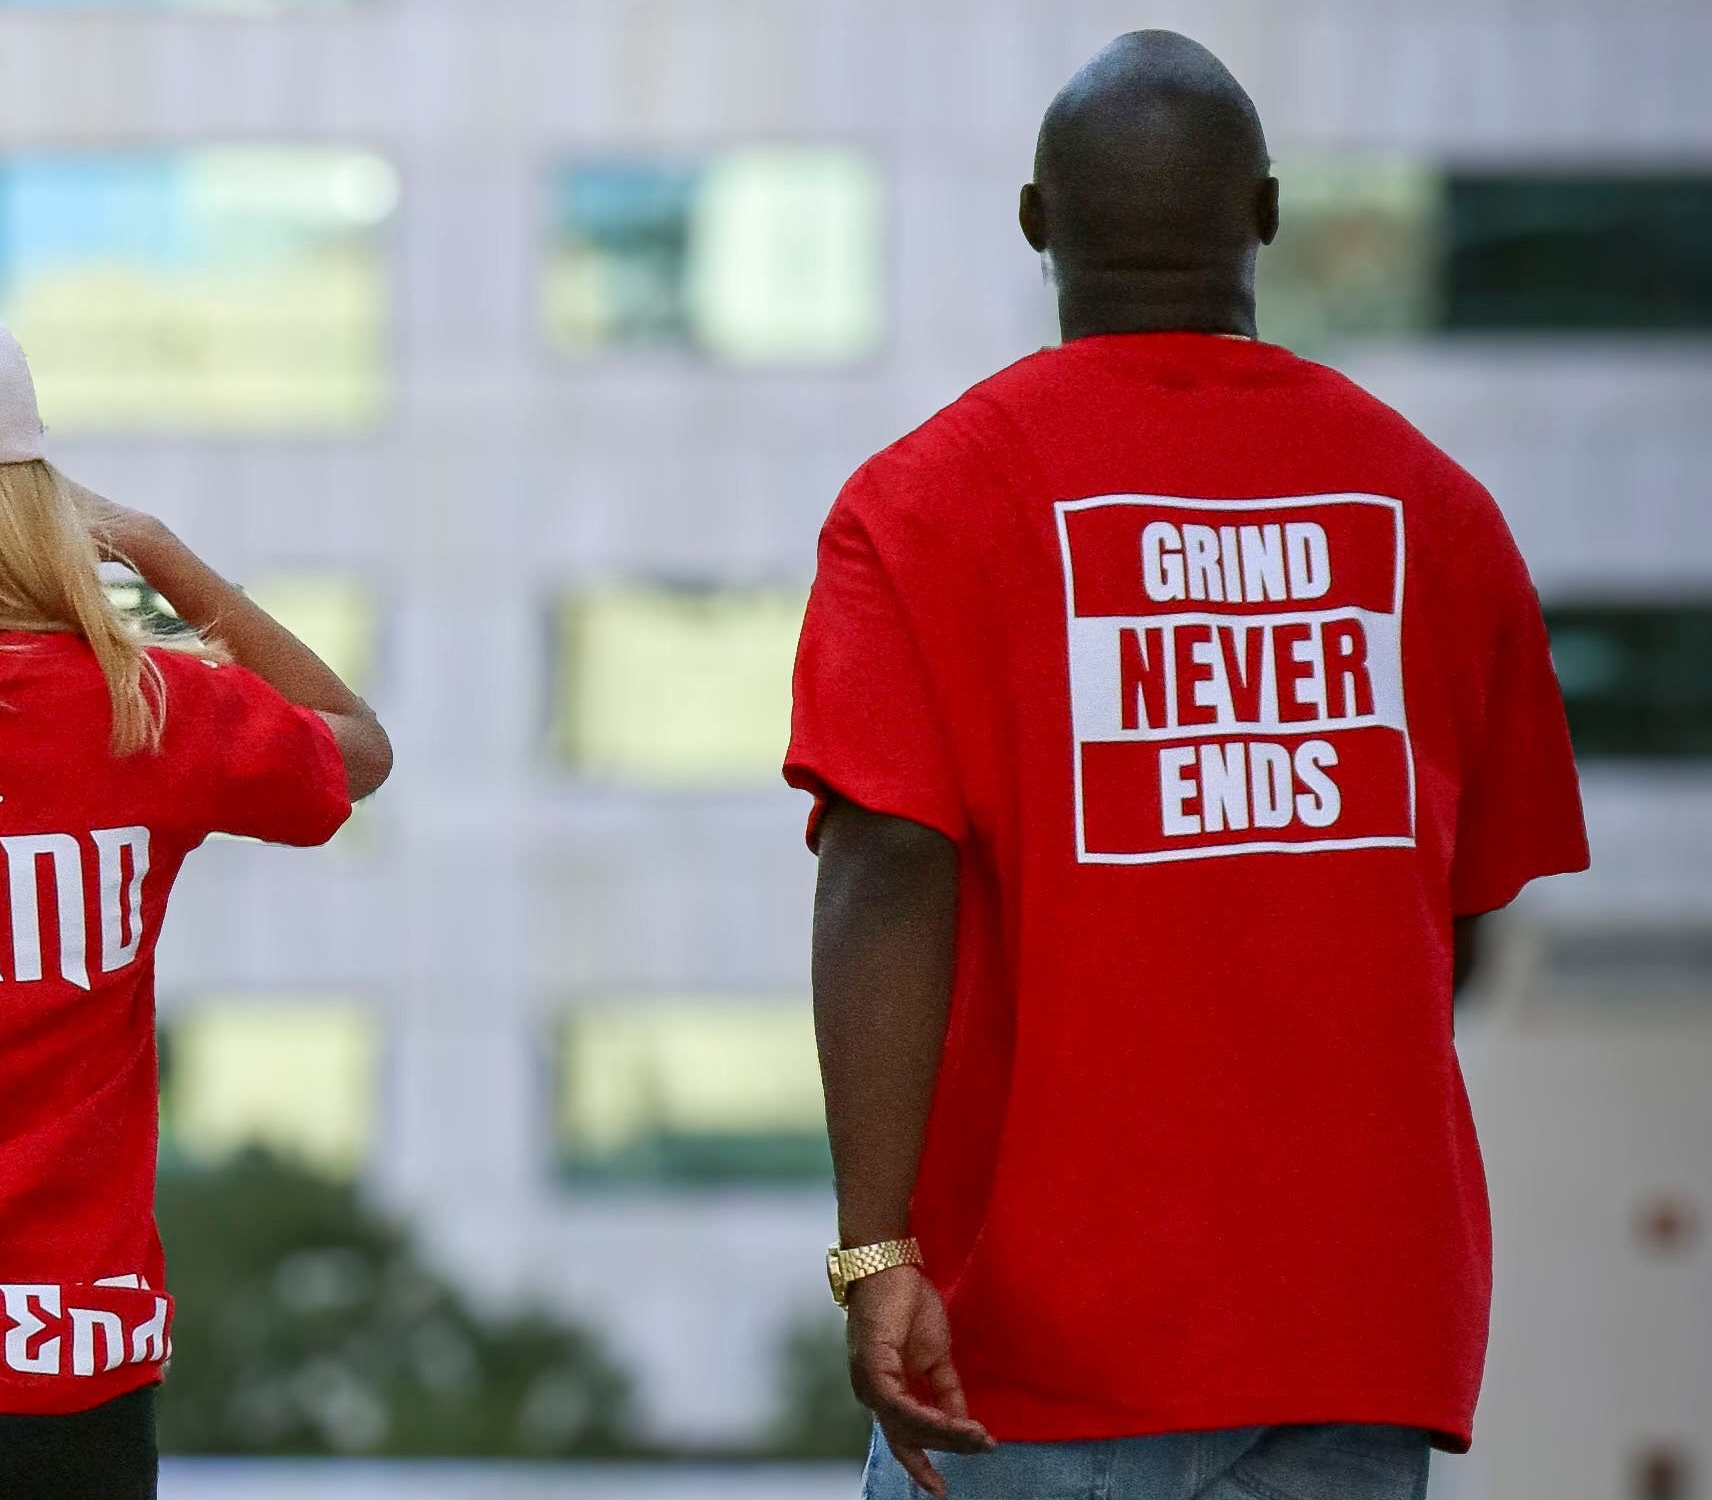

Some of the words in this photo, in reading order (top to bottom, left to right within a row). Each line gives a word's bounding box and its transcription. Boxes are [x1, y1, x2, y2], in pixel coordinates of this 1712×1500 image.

[1142, 521, 1331, 603] GRIND
[1119, 617, 1376, 732] NEVER
[1159, 739, 1342, 837] ENDS
